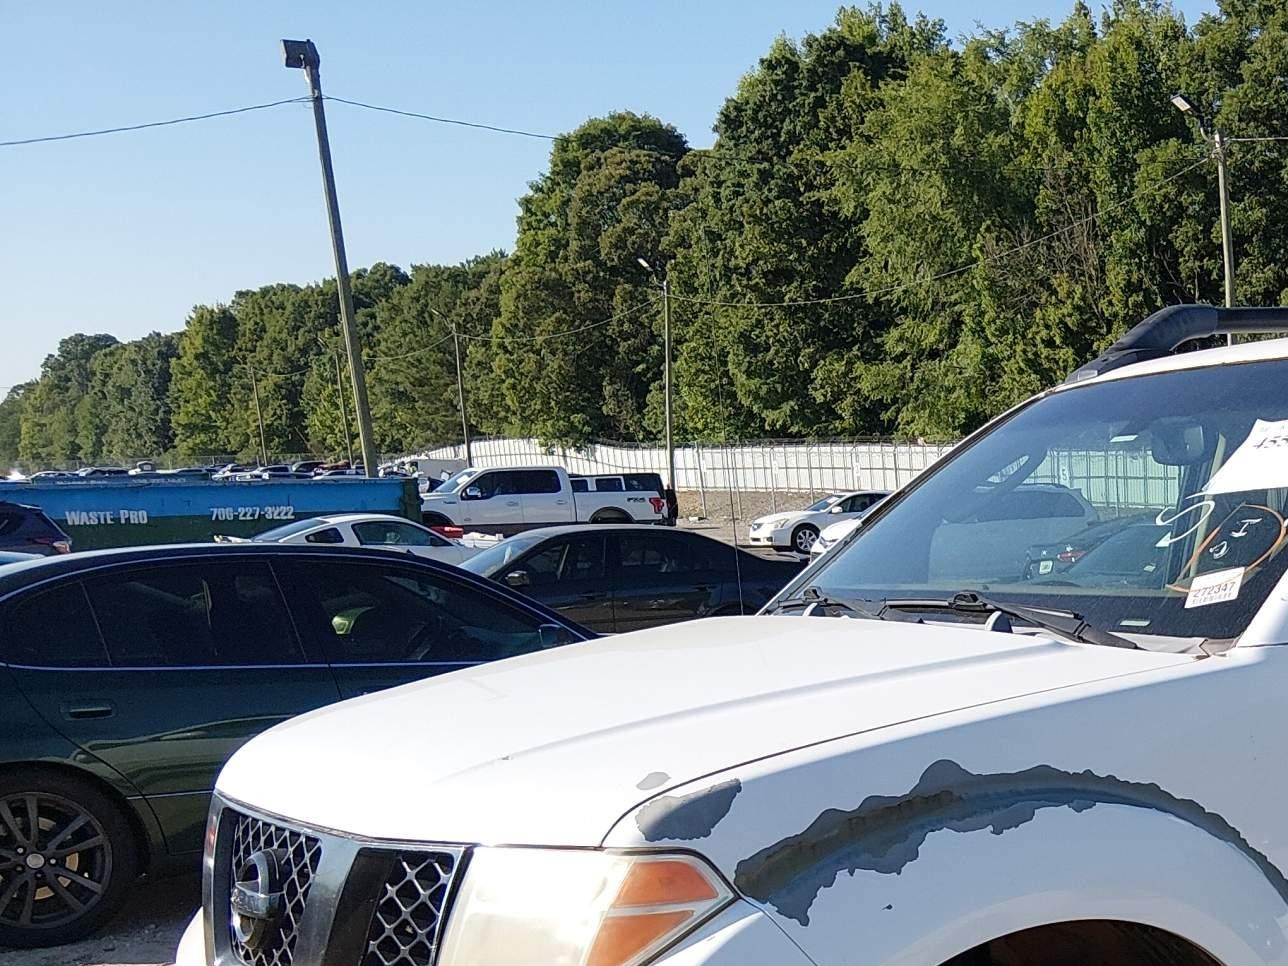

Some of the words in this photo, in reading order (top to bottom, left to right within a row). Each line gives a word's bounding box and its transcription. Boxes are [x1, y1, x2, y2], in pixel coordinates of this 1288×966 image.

[64, 510, 115, 526] WASTE
[119, 509, 148, 525] PRO
[1192, 580, 1236, 599] 272347
